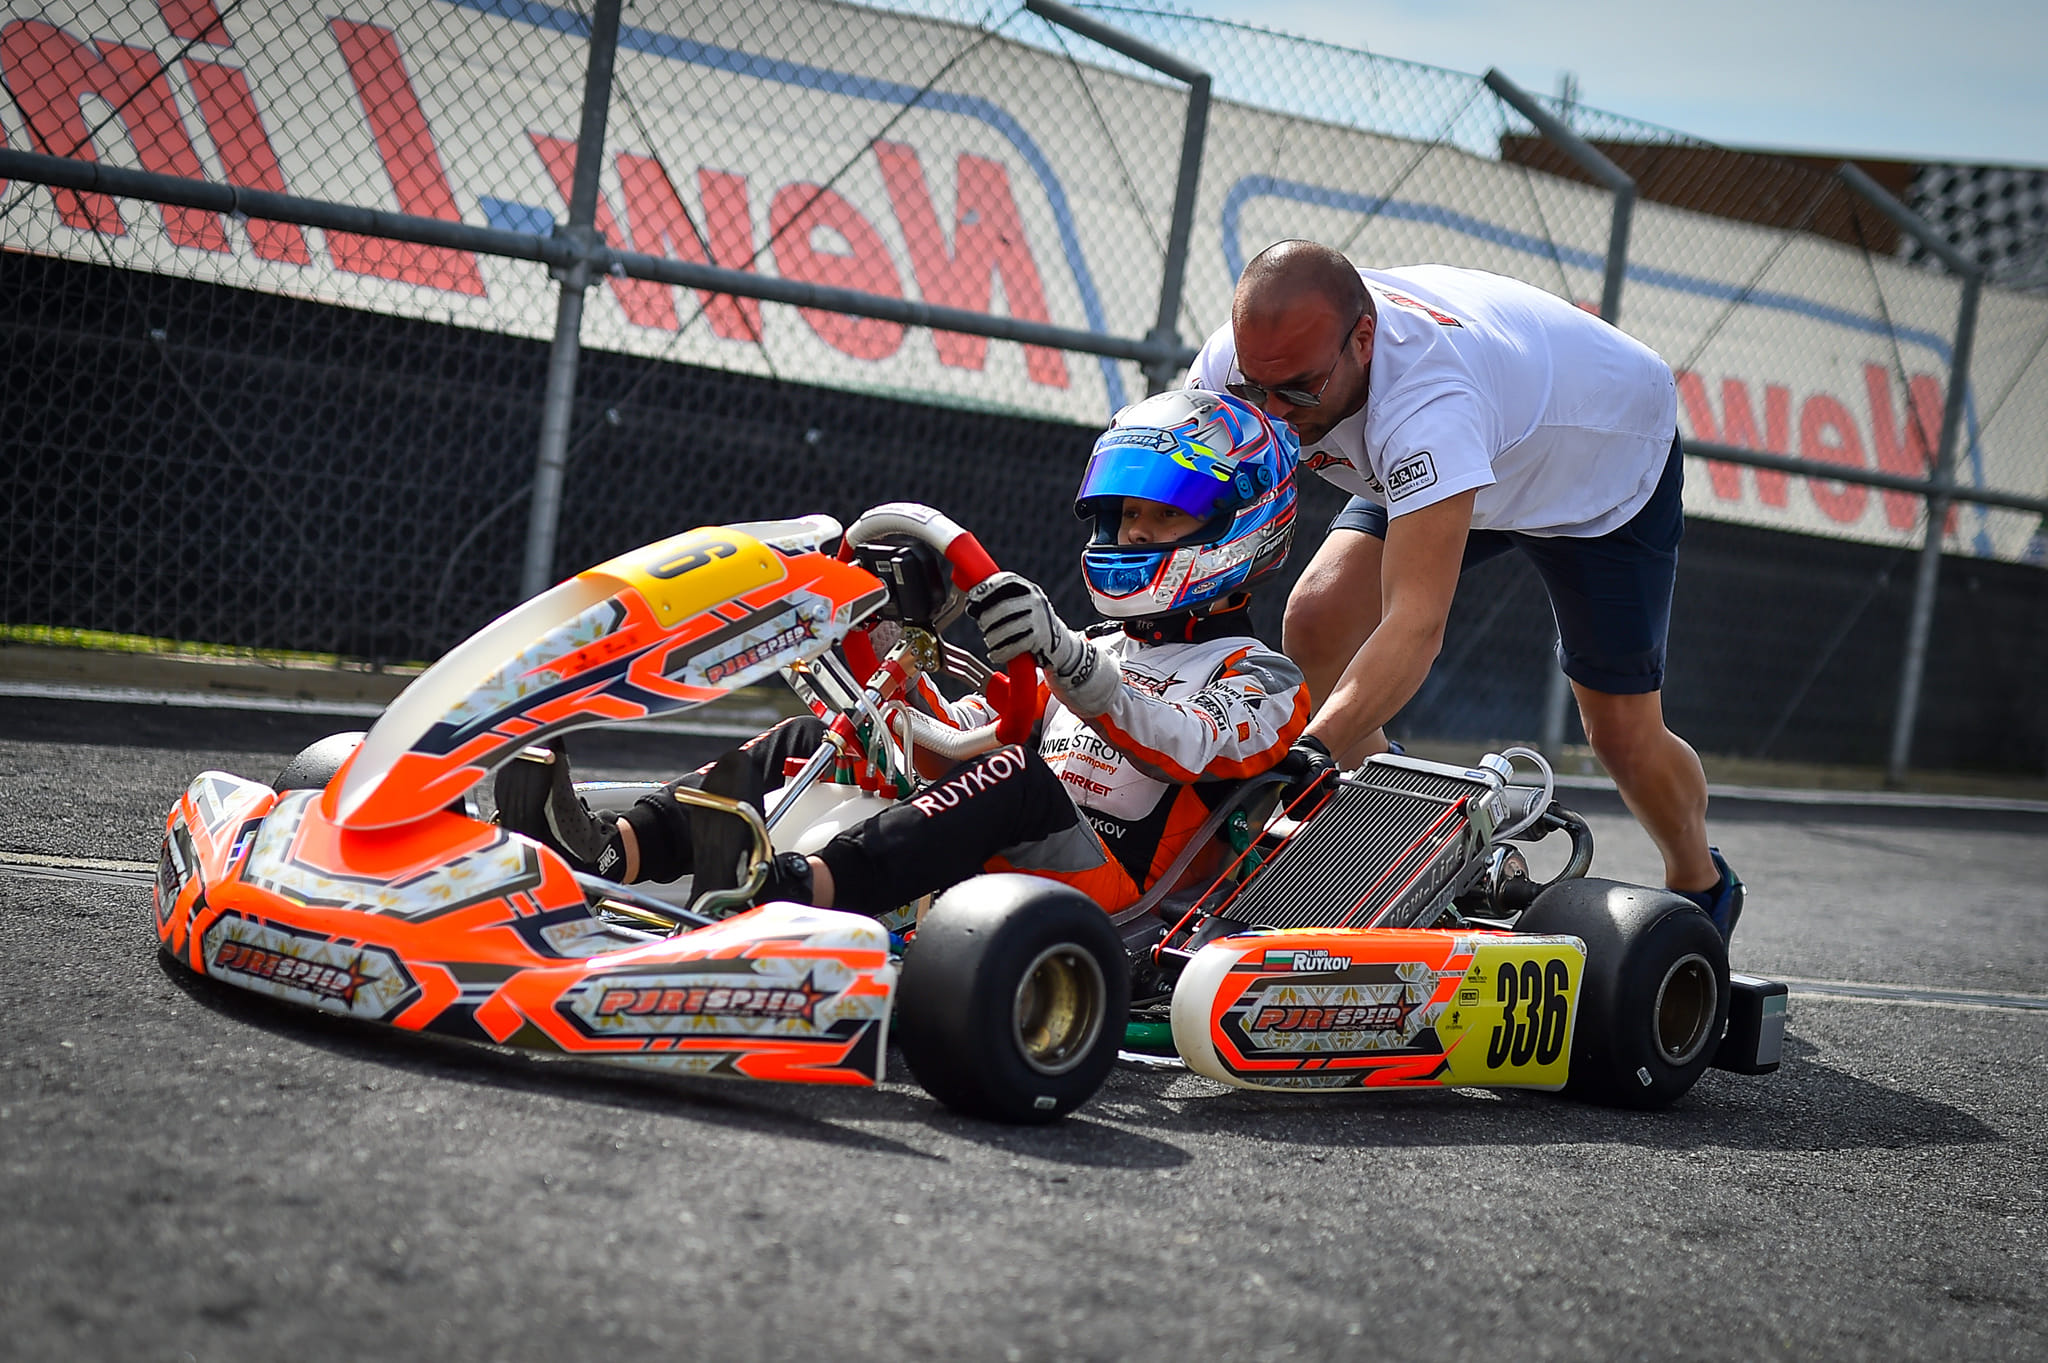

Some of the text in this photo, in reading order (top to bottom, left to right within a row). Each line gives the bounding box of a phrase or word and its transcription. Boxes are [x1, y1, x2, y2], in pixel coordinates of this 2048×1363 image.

[1388, 460, 1427, 490] Z&M
[1076, 752, 1118, 776] company
[911, 744, 1027, 818] RUYKOV
[1292, 952, 1351, 971] RUYKOV
[1309, 949, 1329, 958] LUBO
[1254, 1007, 1401, 1031] PURESPEED
[1486, 958, 1569, 1069] 336
